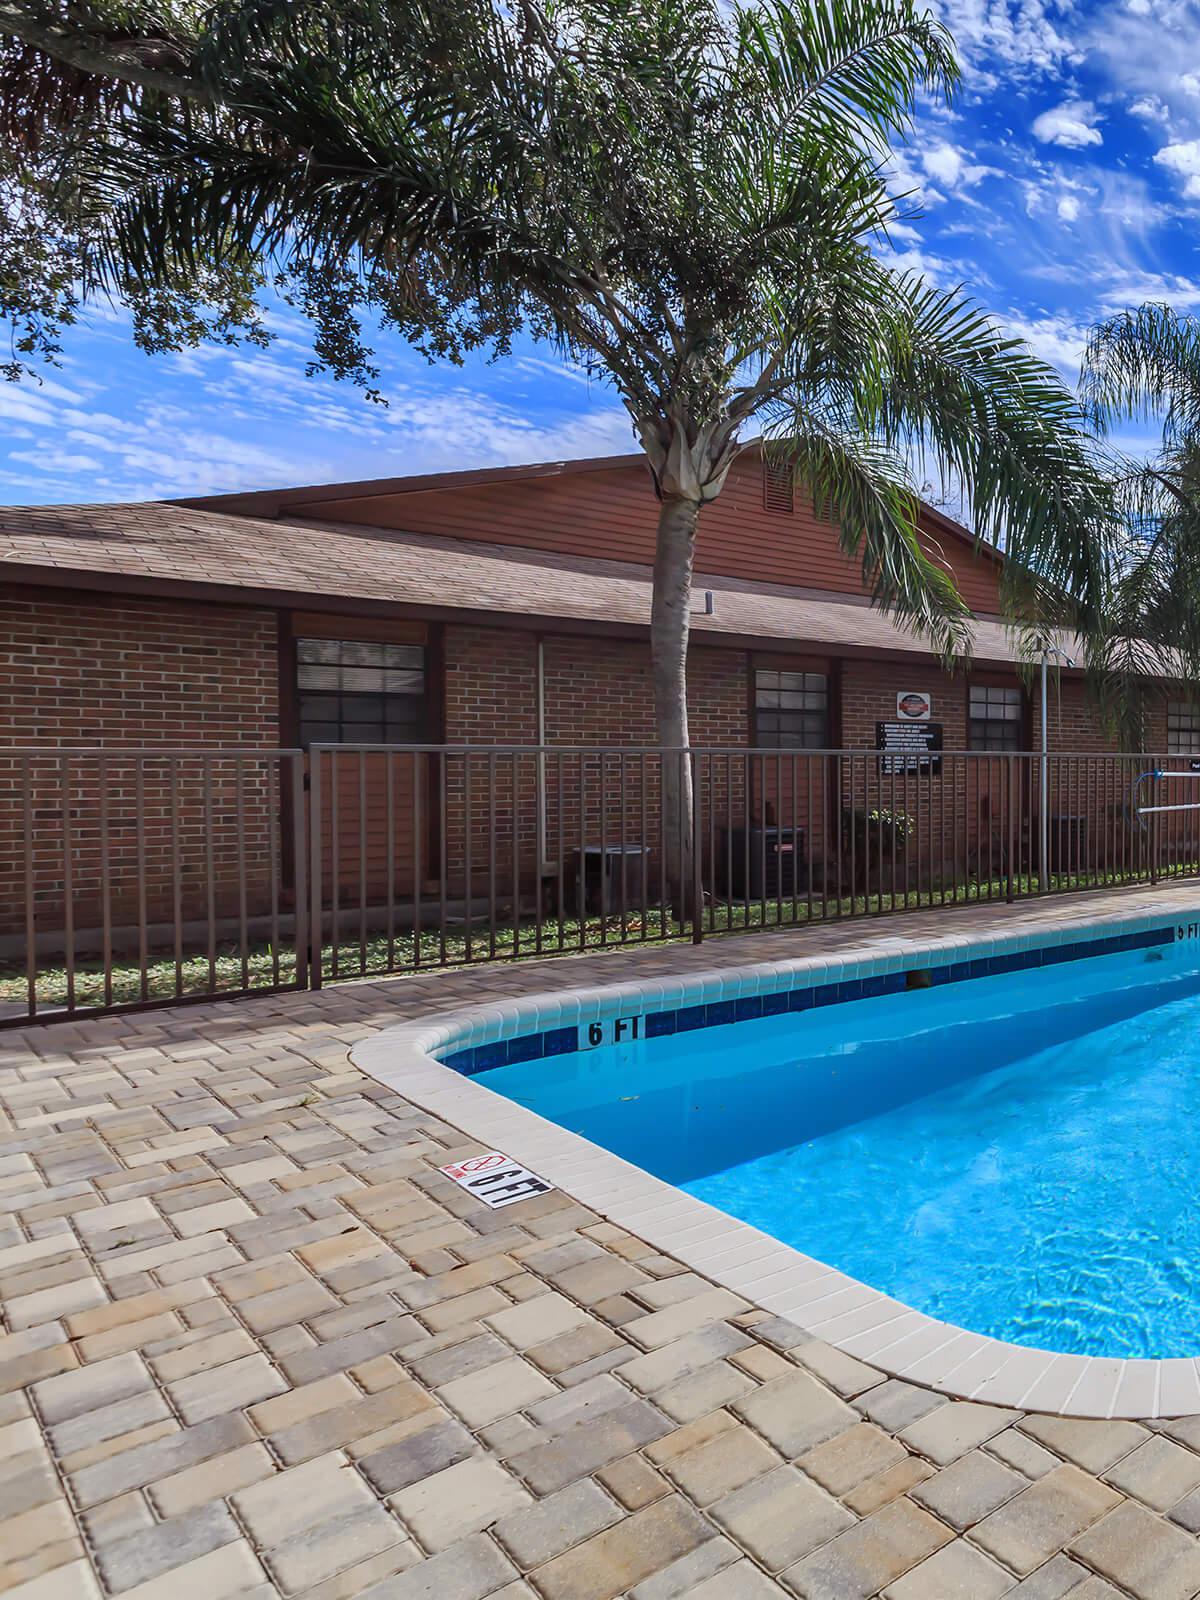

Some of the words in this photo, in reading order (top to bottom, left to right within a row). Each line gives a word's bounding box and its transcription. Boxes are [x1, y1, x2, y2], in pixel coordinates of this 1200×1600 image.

[1188, 923, 1198, 939] FT
[589, 1022, 602, 1046] 6
[615, 1015, 643, 1042] FT
[468, 1169, 523, 1187] 6
[480, 1177, 551, 1203] FT
